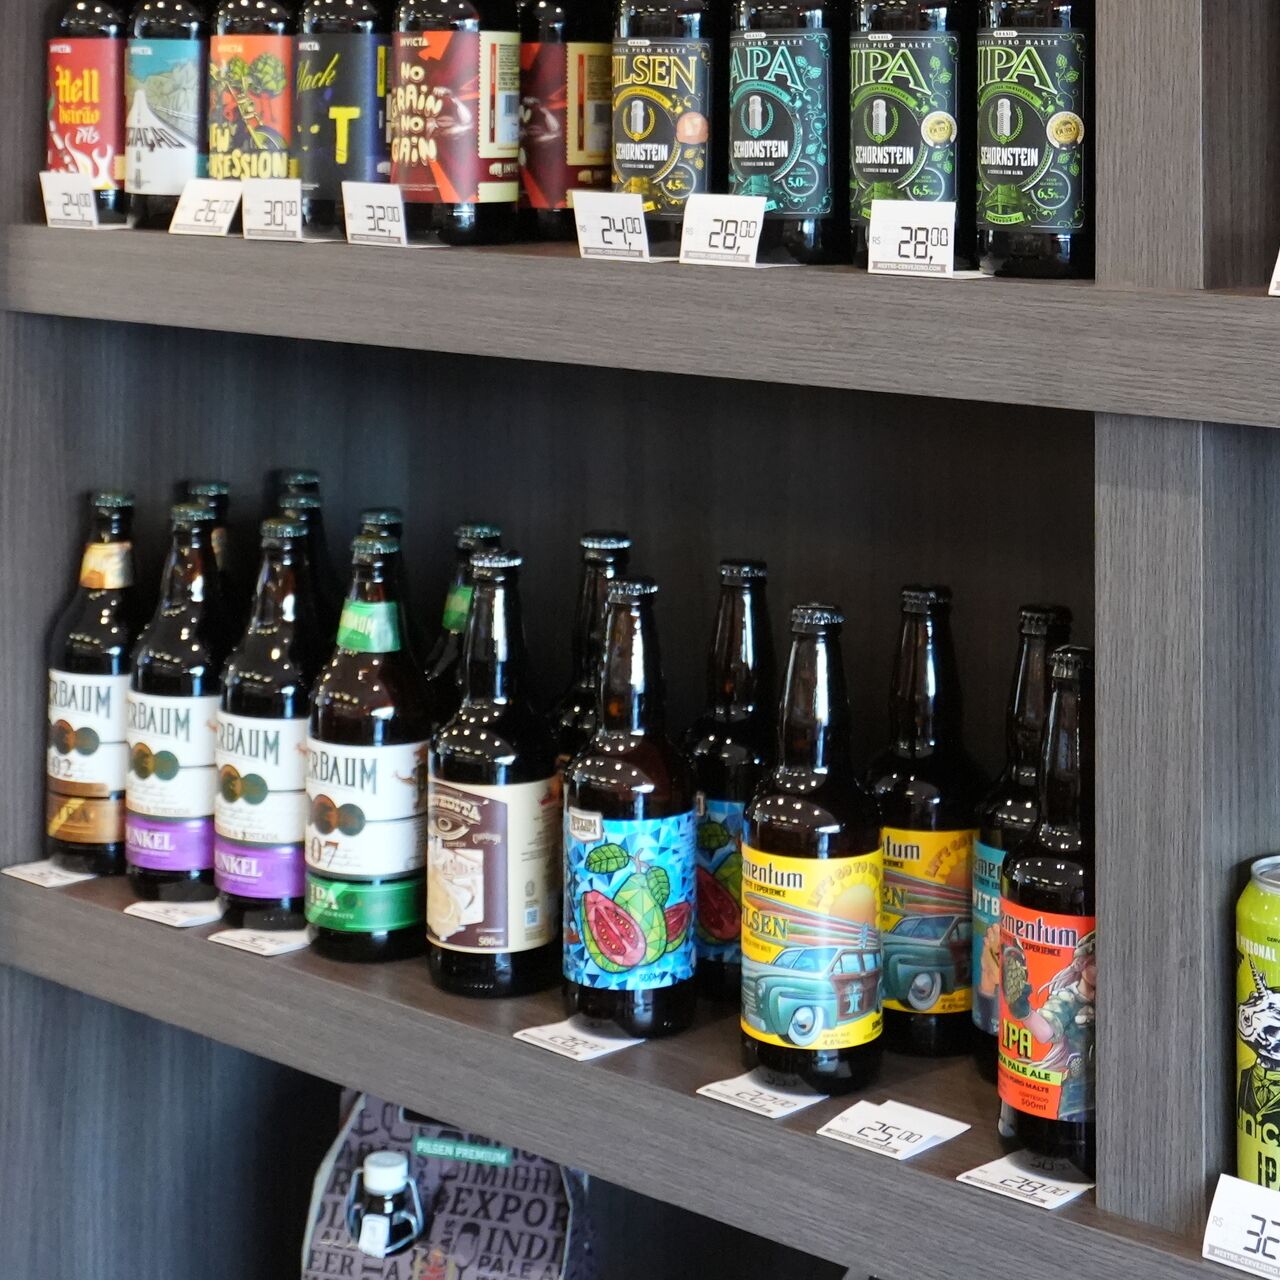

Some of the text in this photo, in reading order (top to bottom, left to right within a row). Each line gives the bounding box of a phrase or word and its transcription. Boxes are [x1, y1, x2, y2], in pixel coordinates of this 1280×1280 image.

[399, 37, 429, 48] INVICTA
[657, 47, 687, 55] MALTE
[772, 39, 804, 47] MALTE
[905, 41, 933, 49] MALTE
[1024, 39, 1059, 47] MALTE
[400, 61, 425, 82] NO
[730, 45, 805, 92] APA
[850, 48, 932, 96] IPA
[977, 46, 1059, 96] IPA
[55, 65, 100, 104] Hell
[391, 83, 444, 118] GRAIN
[400, 114, 424, 134] NO
[391, 136, 438, 166] GAIN
[615, 142, 669, 162] SCHORNSTEIN
[733, 139, 789, 159] SCHORNSTEIN
[855, 145, 914, 166] SCHORNSTEIN
[980, 146, 1039, 167] SCHORNSTEIN
[193, 199, 234, 226] 26,00
[264, 200, 298, 231] 30,00
[364, 204, 400, 237] 32,00
[599, 215, 643, 251] 24,00
[708, 219, 757, 254] 28,00
[897, 225, 950, 264] 28,00
[309, 835, 340, 870] 07
[1022, 941, 1062, 958] EXPERIENCE
[1001, 1017, 1034, 1060] IPA
[1008, 1060, 1051, 1082] PALE ALE
[1020, 1098, 1047, 1111] 500ml
[855, 1120, 925, 1150] 25,00
[454, 1145, 507, 1165] PREMIUM
[1000, 1174, 1071, 1201] 28,00
